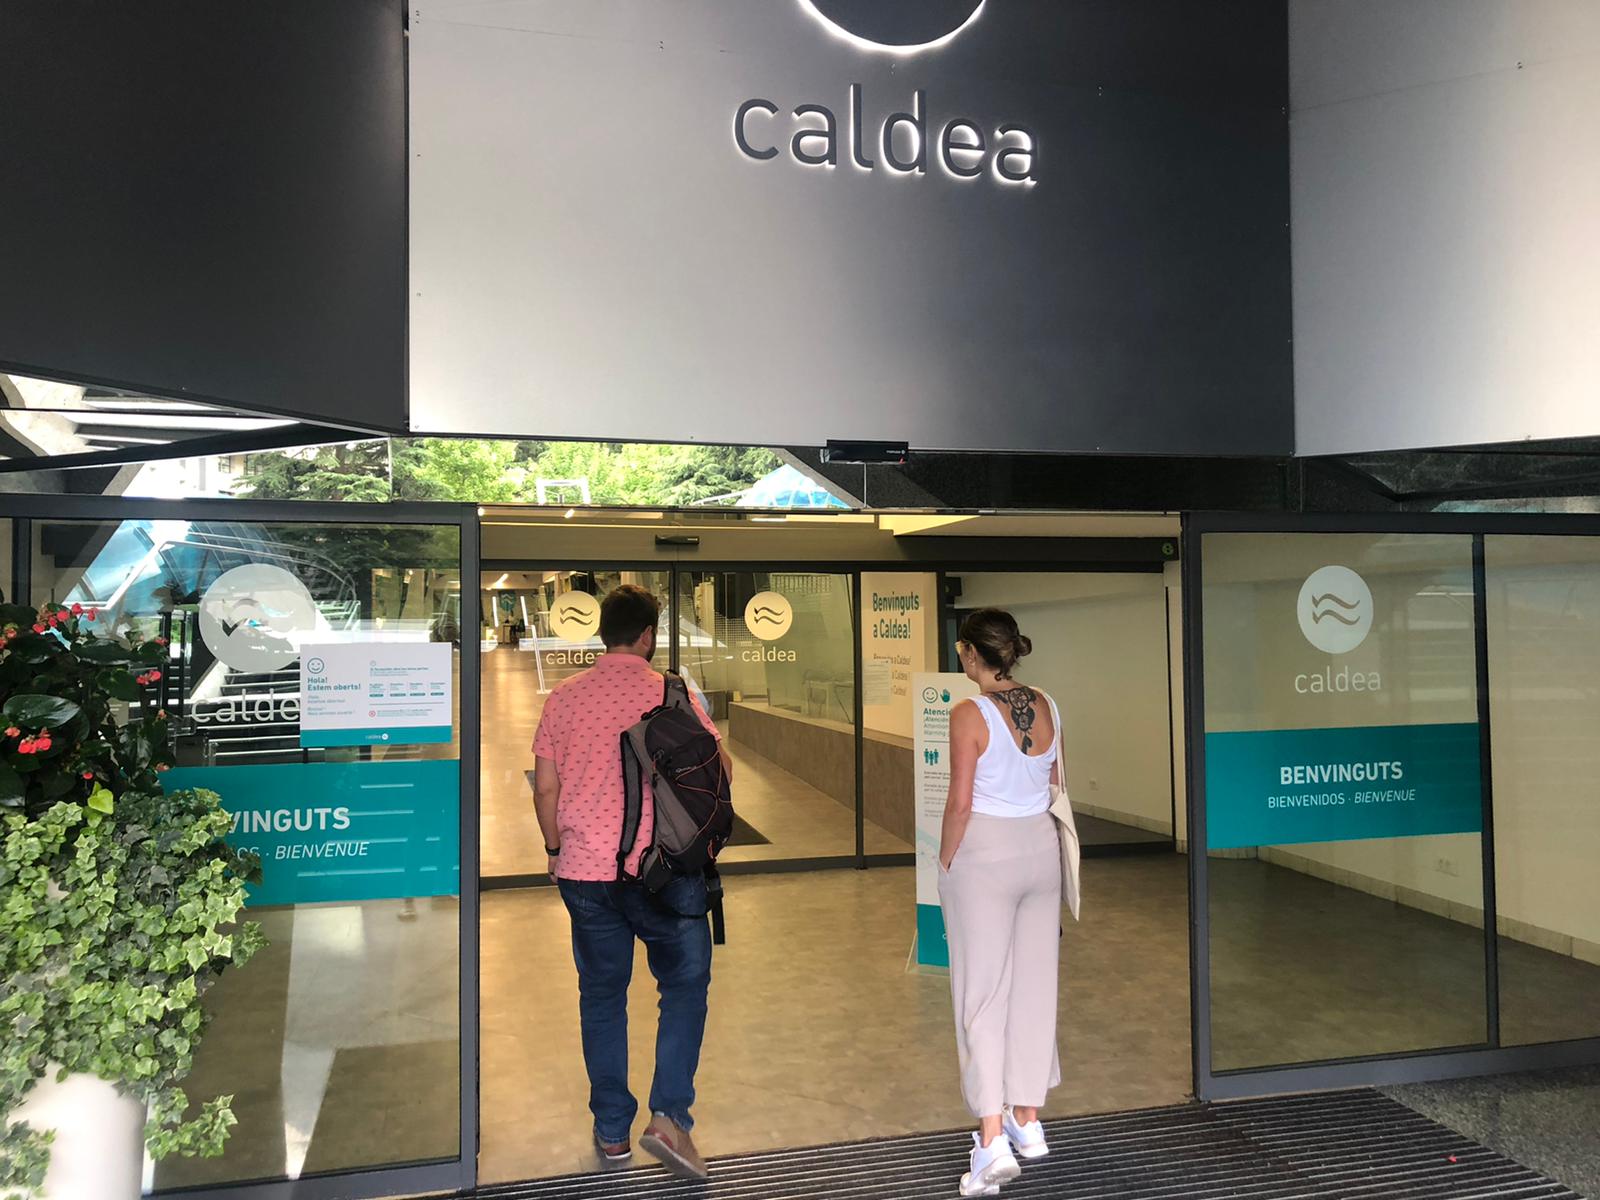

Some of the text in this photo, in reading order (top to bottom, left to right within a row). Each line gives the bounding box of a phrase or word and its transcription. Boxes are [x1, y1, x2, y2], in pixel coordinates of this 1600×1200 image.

[733, 83, 1038, 185] caldea
[872, 591, 920, 616] Benvinguts
[873, 618, 911, 639] a Caldea!
[741, 646, 797, 662] caldea
[307, 676, 328, 684] Hola!
[1294, 665, 1382, 693] caldea
[191, 688, 300, 723] calde
[1280, 761, 1404, 786] BENVINGUTS
[1268, 789, 1417, 809] BIENVENIDOS BIENVENUE
[228, 806, 351, 834] VINGUTS
[275, 841, 371, 860] BIENVENUE
